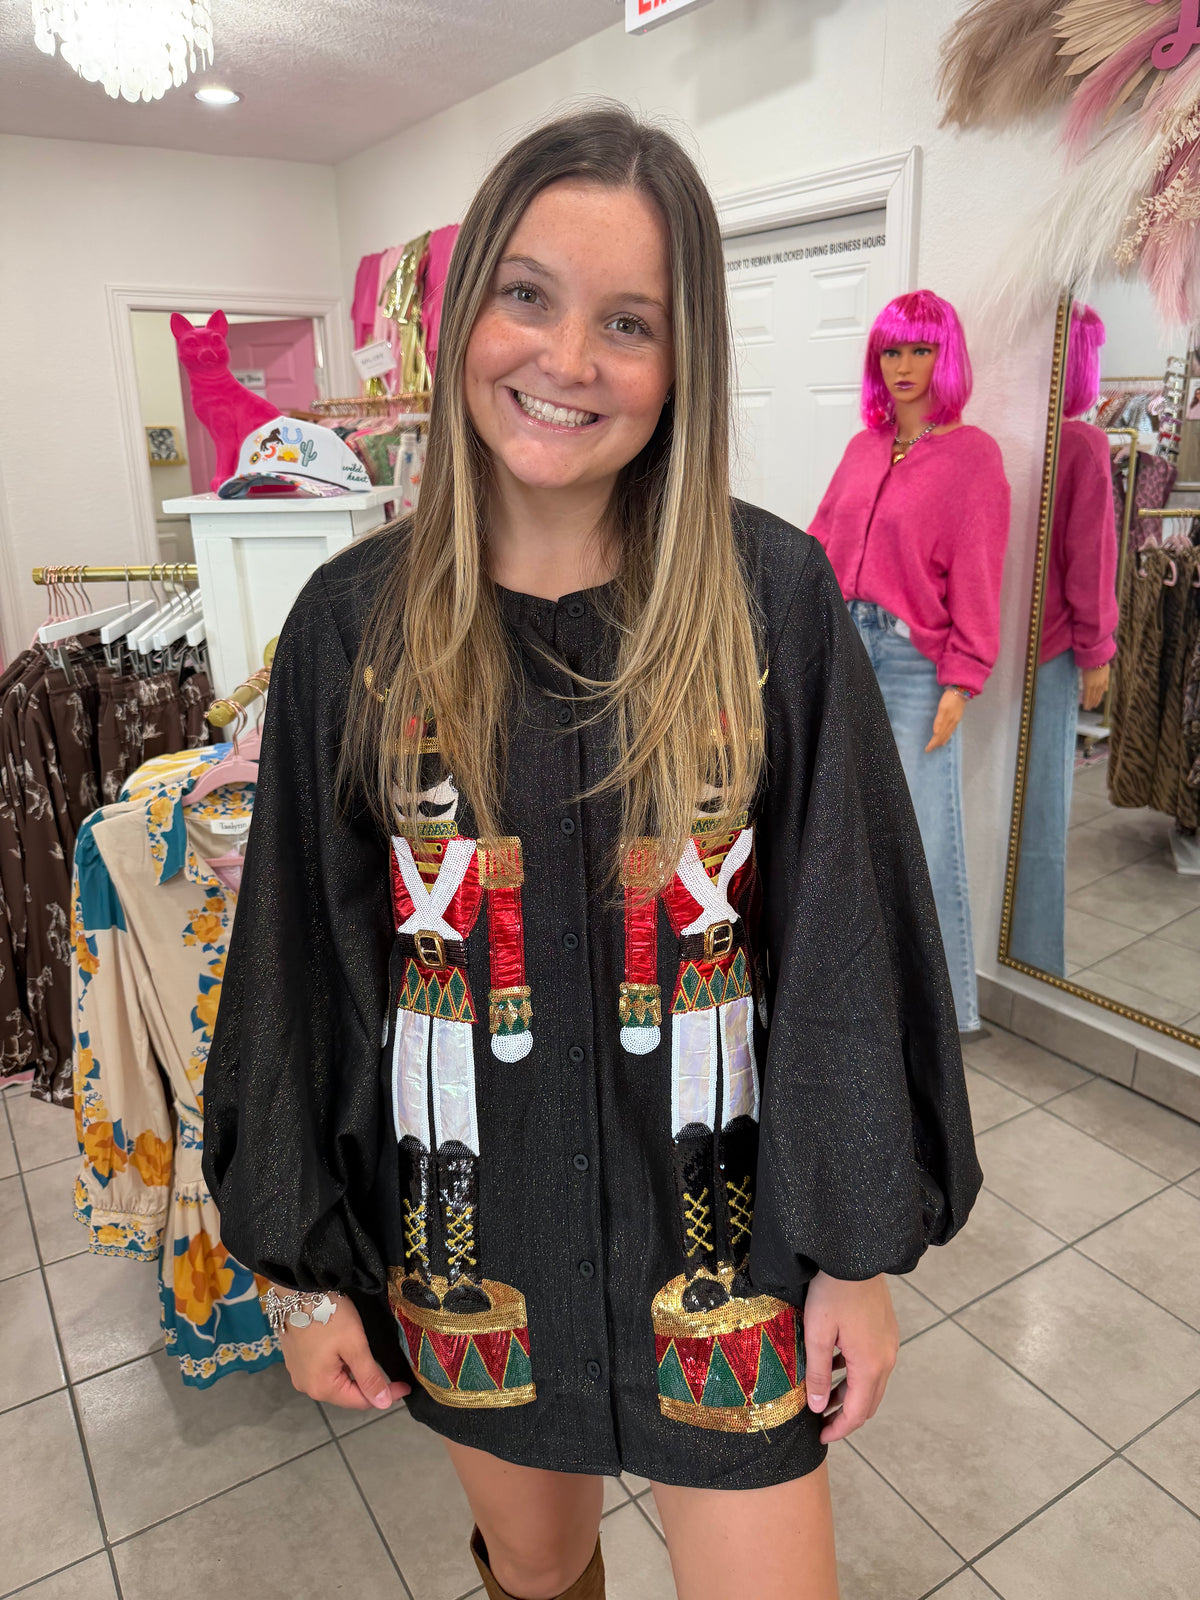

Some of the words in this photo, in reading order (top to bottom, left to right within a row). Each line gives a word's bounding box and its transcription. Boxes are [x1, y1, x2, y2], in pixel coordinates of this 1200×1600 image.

[742, 258, 750, 269] TO
[751, 254, 772, 267] REMAIN
[773, 249, 804, 264] UNLOCKED
[804, 245, 828, 259] DURING
[829, 239, 860, 255] BUSINESS
[862, 234, 886, 249] HOURS
[342, 463, 364, 473] wild
[346, 472, 369, 483] heart
